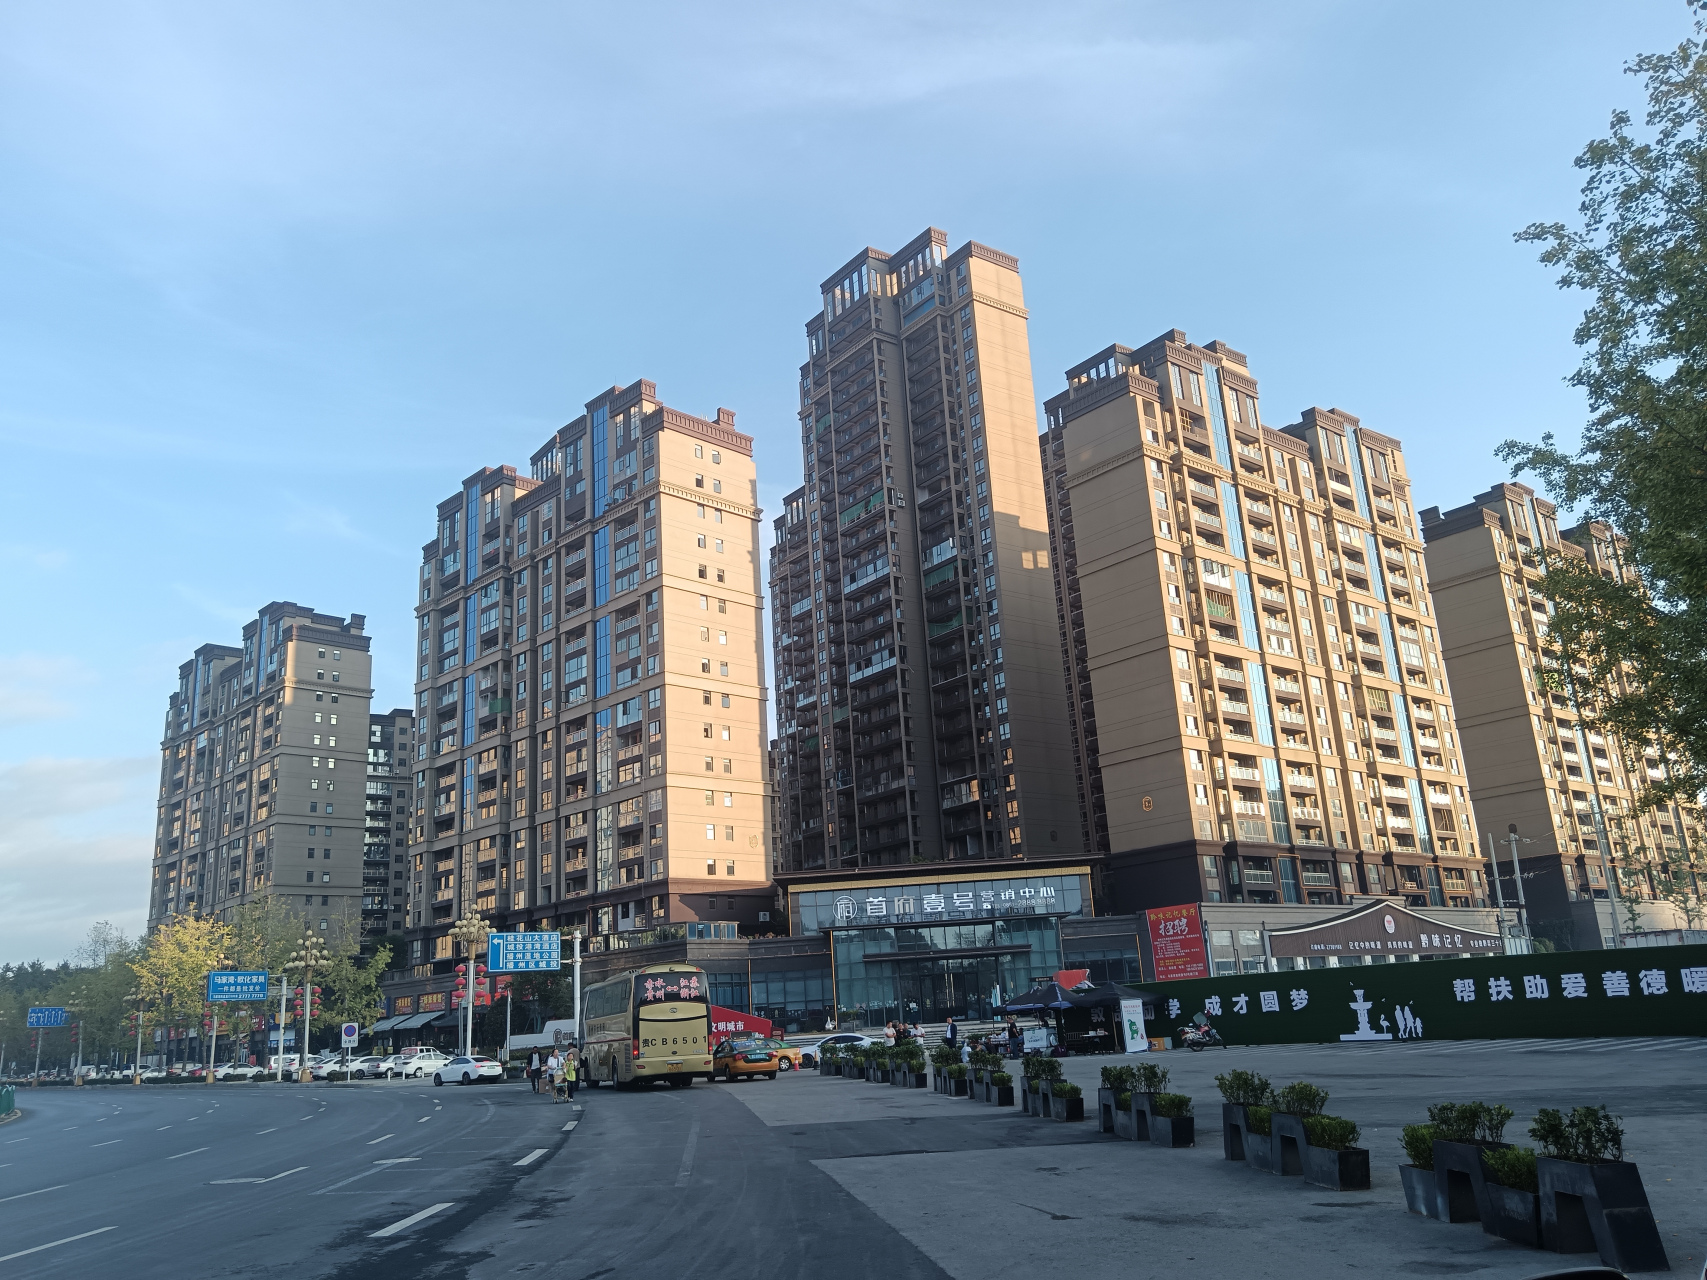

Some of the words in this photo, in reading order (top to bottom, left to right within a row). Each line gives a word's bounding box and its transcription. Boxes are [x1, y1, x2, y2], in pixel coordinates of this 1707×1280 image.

[866, 892, 974, 916] 首府壹号
[980, 886, 1055, 901] 营销中心
[1159, 917, 1188, 936] 招聘
[1420, 933, 1463, 948] 黔味记忆
[680, 976, 700, 988] 江苏
[645, 988, 665, 1001] 贵州
[680, 988, 700, 1000] 浙江
[1204, 988, 1309, 1017] 成才圆梦
